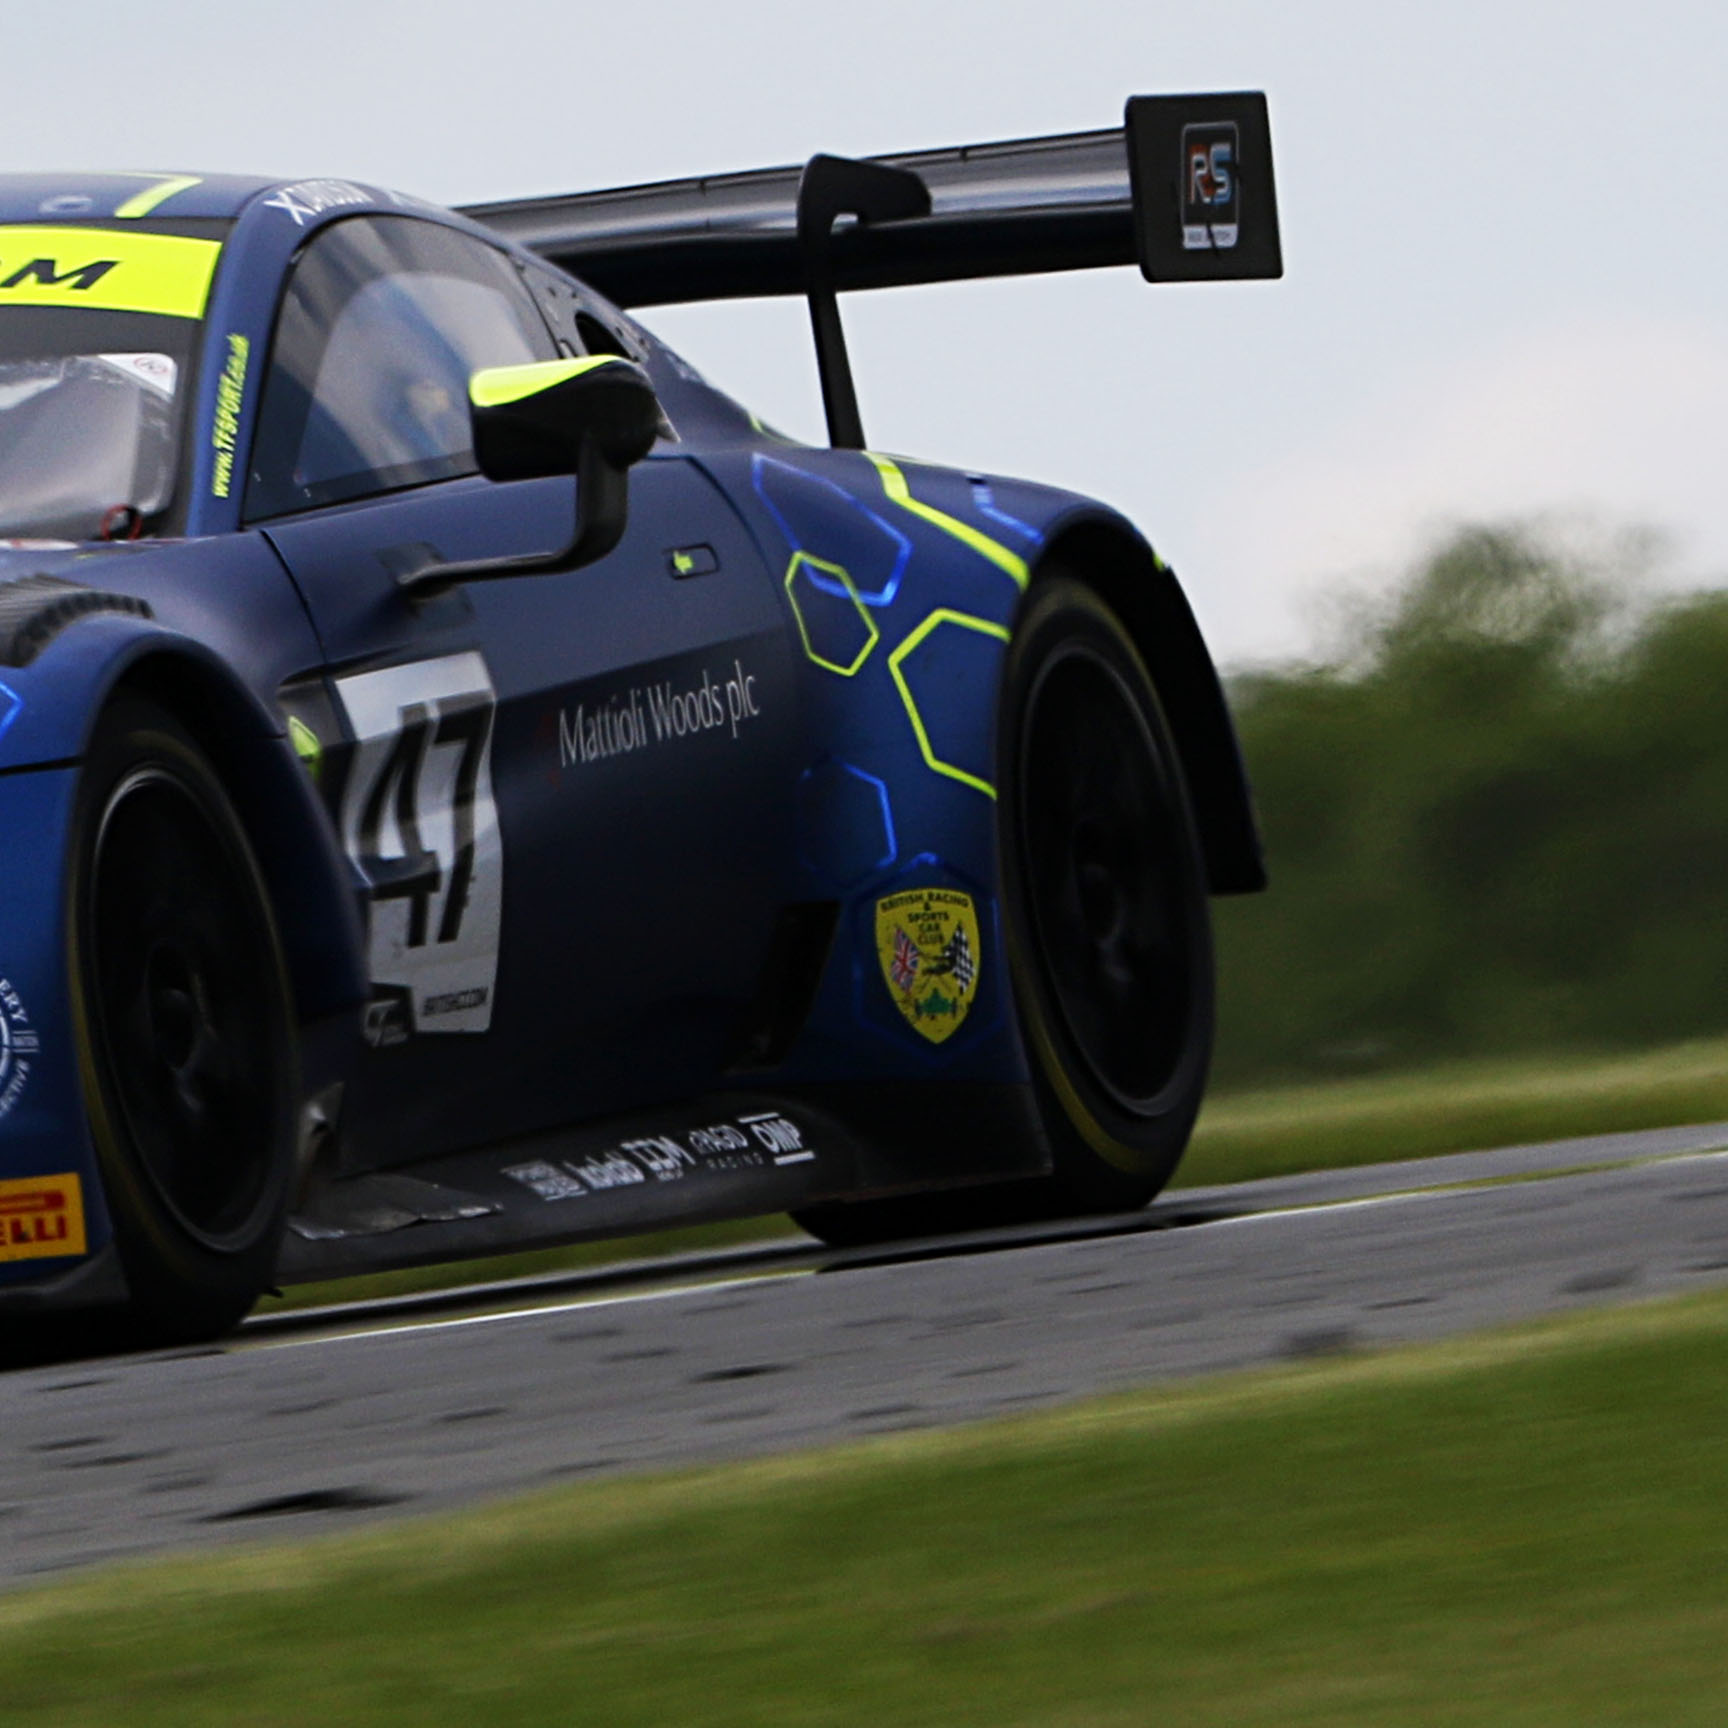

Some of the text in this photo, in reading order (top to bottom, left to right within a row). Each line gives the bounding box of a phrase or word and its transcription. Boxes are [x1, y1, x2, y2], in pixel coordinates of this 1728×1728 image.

[559, 659, 760, 768] Mattioli Woods plc
[357, 687, 495, 949] 47
[880, 890, 969, 912] BRITISH RACING
